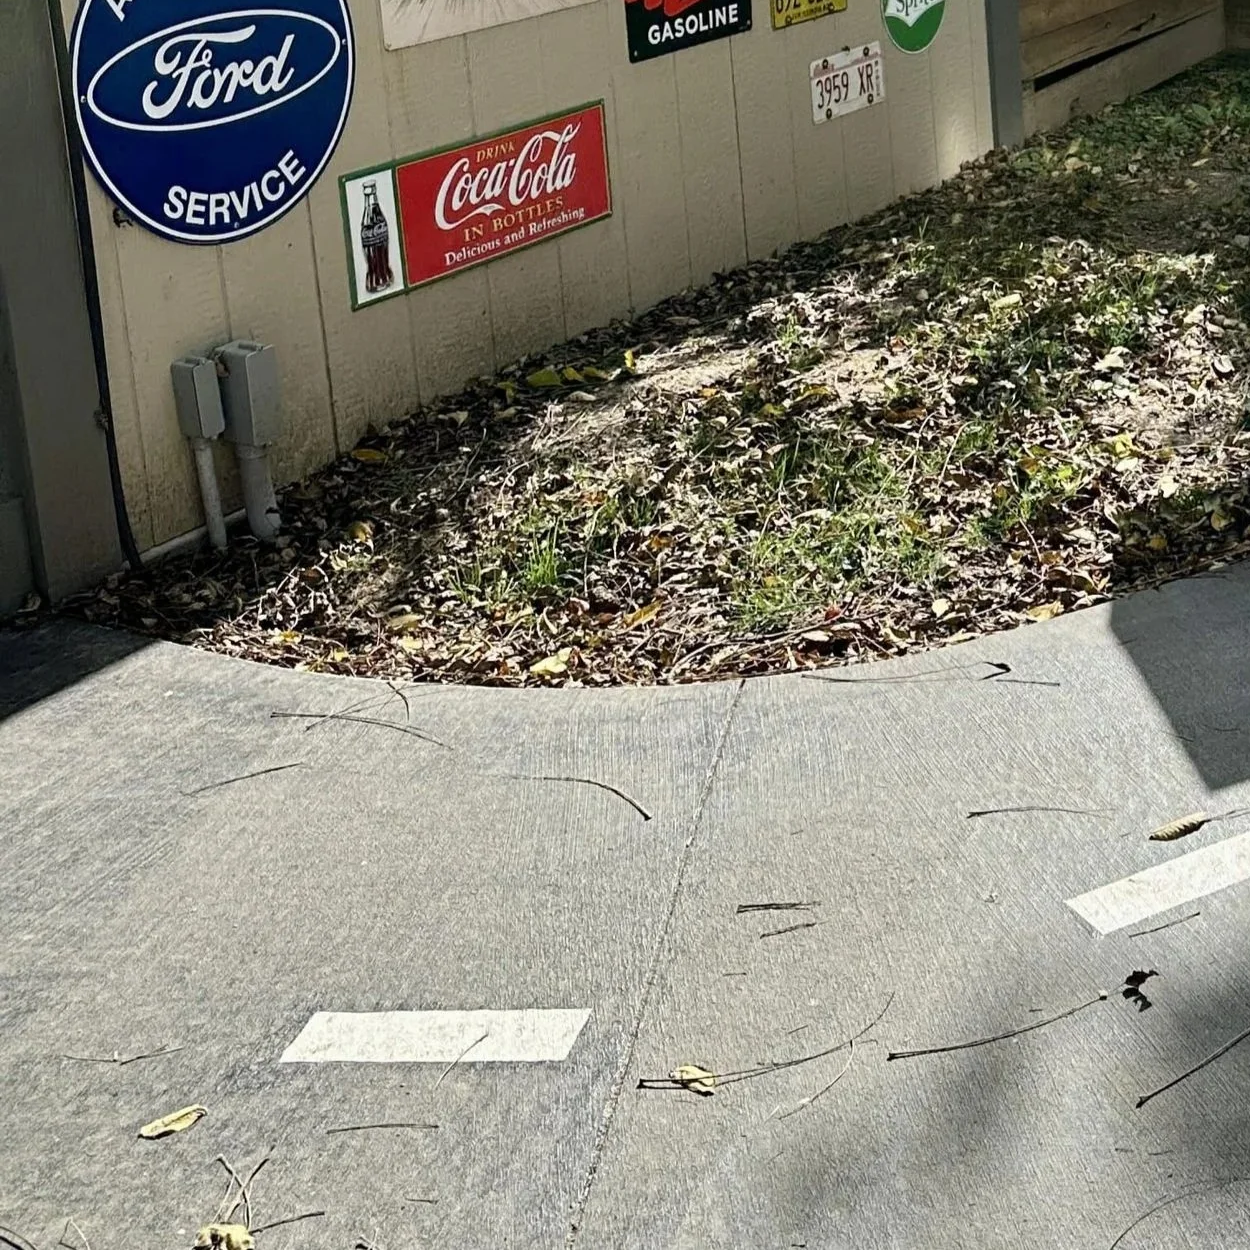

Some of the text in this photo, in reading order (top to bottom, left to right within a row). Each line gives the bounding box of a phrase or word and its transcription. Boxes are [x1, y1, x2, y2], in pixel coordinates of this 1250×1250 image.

[648, 3, 738, 45] GASOLINE
[142, 24, 296, 119] Ford
[816, 71, 849, 109] 3959
[857, 63, 874, 96] XR
[435, 121, 582, 231] Coca-Cola
[475, 141, 516, 164] DRINK
[163, 149, 306, 227] SERVICE
[444, 207, 585, 266] Delicious and Refreshing
[463, 196, 563, 243] IN BOTTLES
